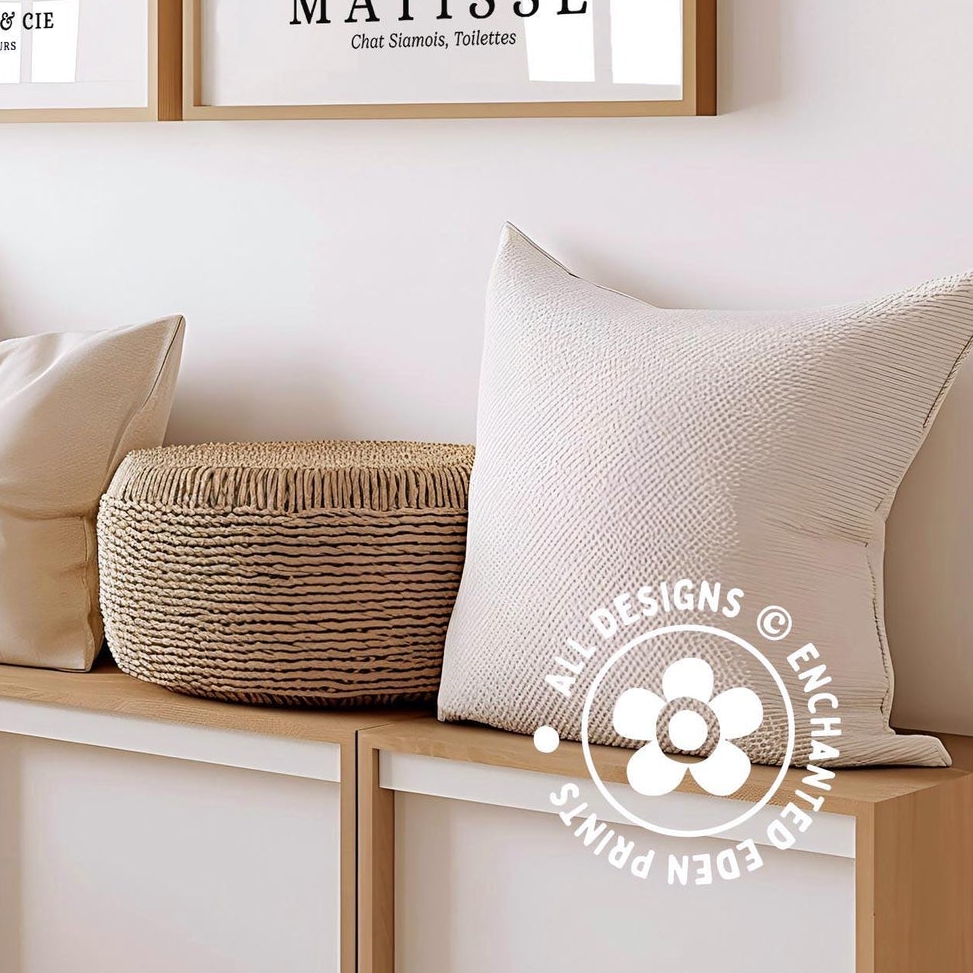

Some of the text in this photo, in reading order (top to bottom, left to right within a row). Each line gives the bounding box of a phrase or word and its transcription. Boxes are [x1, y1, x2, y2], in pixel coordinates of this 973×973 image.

[0, 11, 16, 31] &
[22, 11, 54, 31] CIE
[351, 29, 517, 50] Chat Siamois, Toilettes
